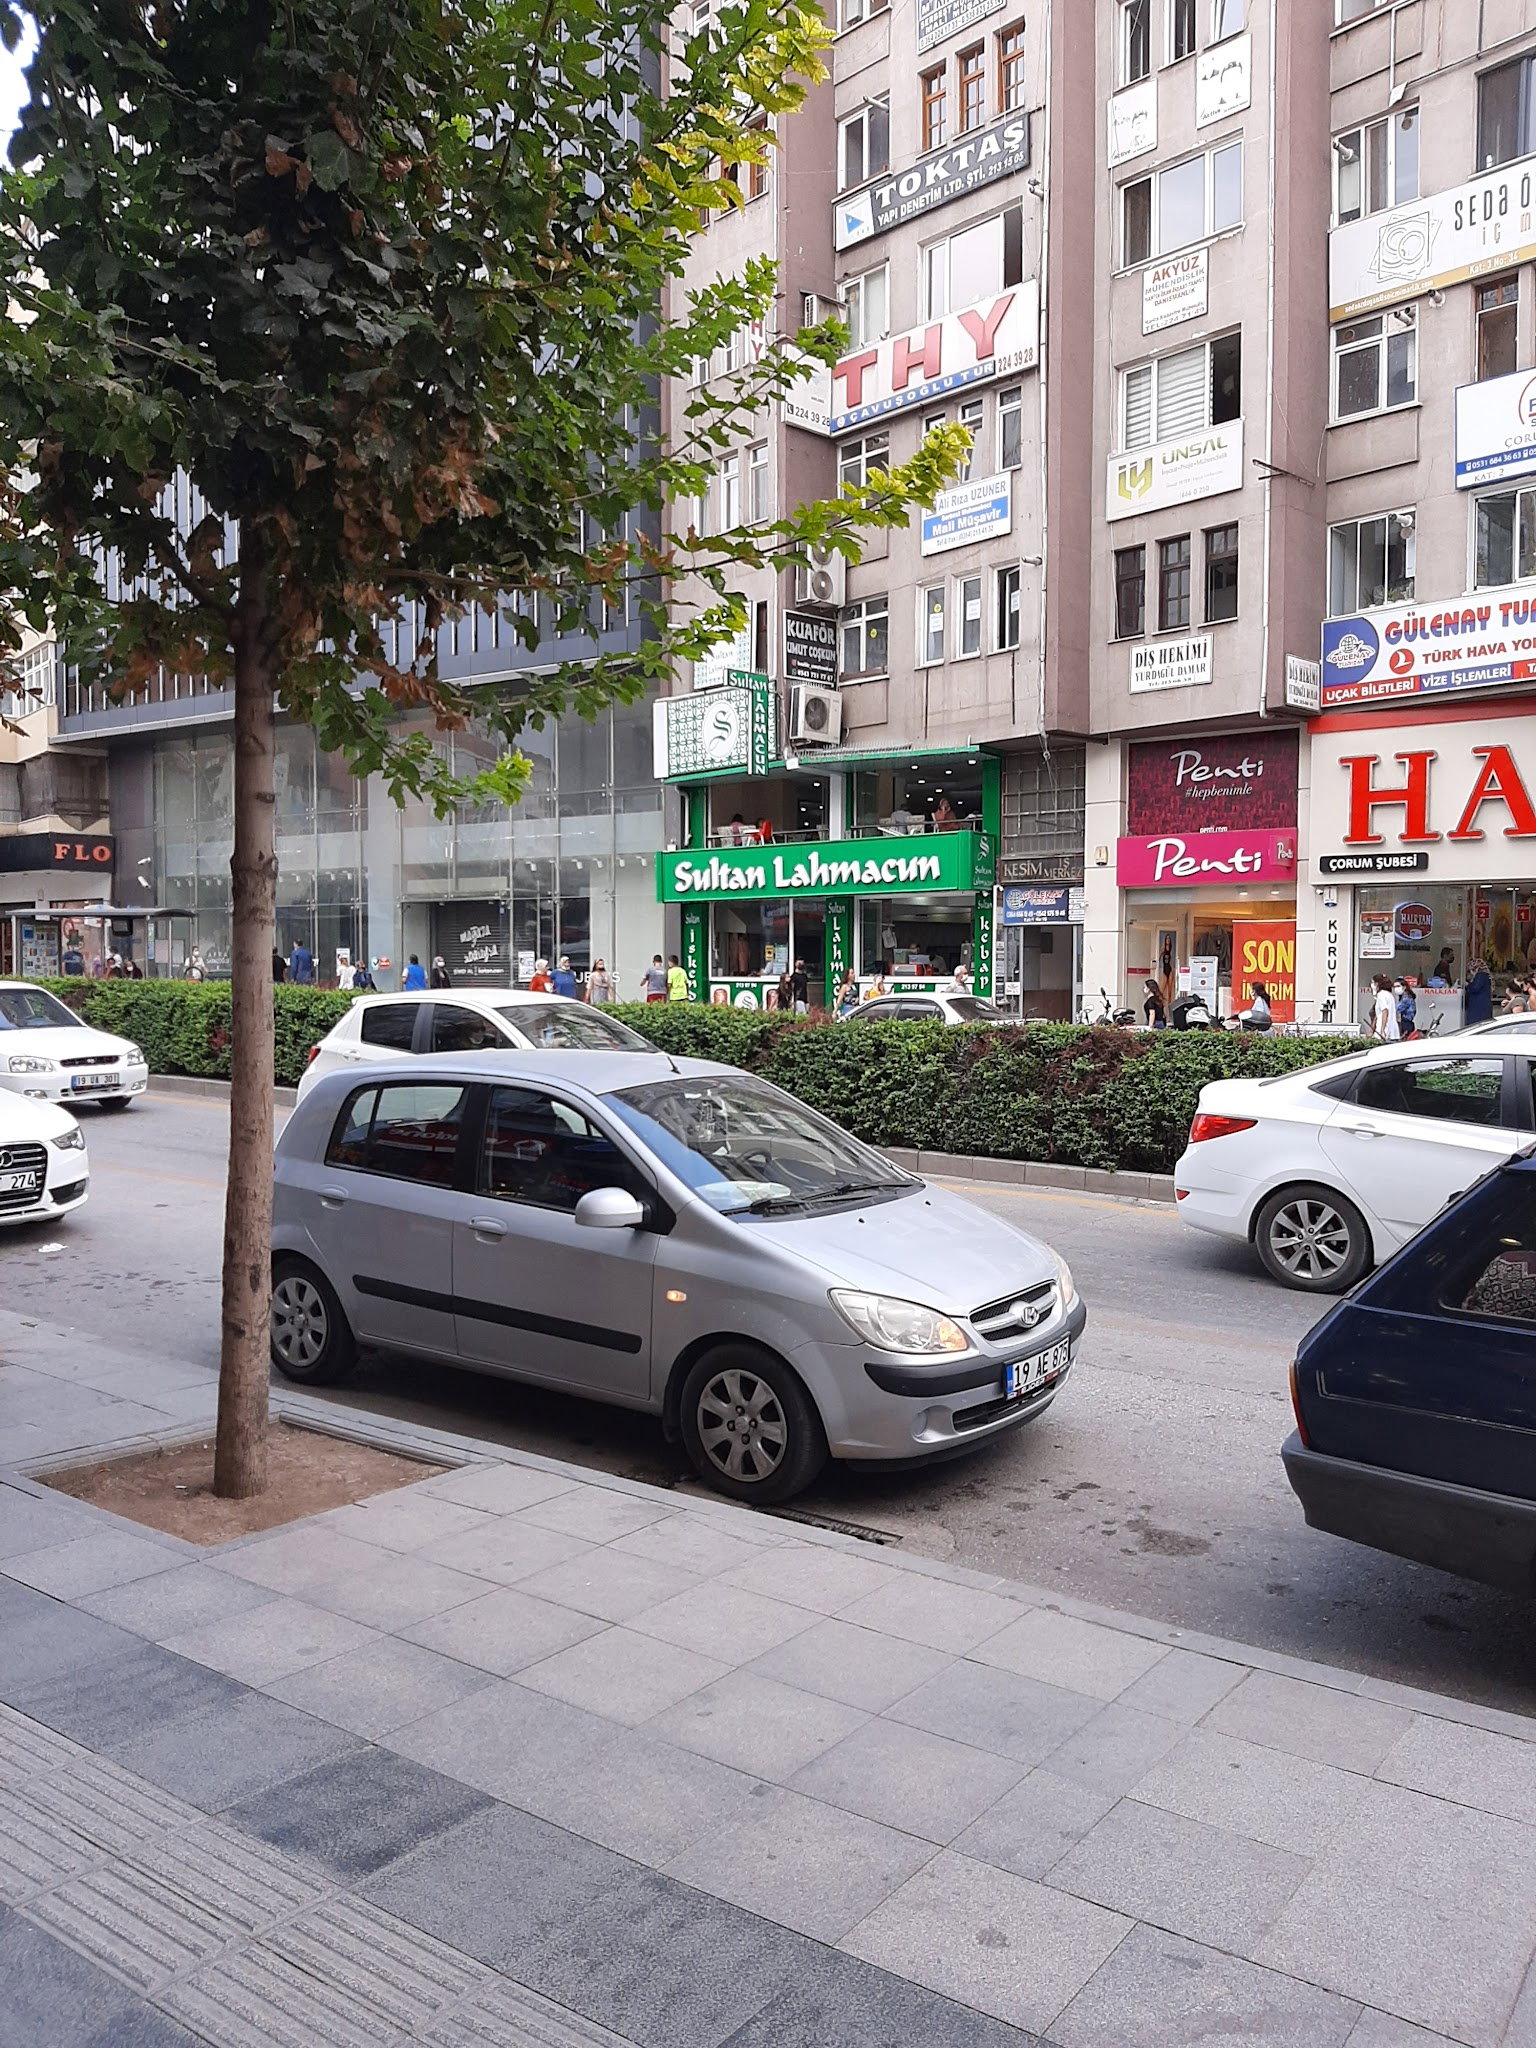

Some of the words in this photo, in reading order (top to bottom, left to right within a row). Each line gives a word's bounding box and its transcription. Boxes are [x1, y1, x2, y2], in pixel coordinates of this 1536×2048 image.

[875, 120, 1025, 208] TOKTAŞ
[877, 209, 899, 227] YAPI
[900, 187, 942, 216] DENETİM
[943, 177, 965, 197] LTD.
[966, 164, 986, 188] ŞTİ.
[1152, 255, 1200, 284] AKYÜZ
[833, 293, 1016, 409] THY
[849, 376, 954, 424] ÇAVUŞOĞLU
[960, 361, 994, 381] TUR
[1013, 352, 1024, 367] 39
[1023, 347, 1034, 363] 28
[795, 406, 809, 420] 224
[810, 412, 820, 423] 39
[938, 497, 950, 511] Ali
[951, 494, 969, 507] Rıza
[970, 480, 1006, 501] UZUNER
[786, 618, 836, 646] KUAFÖR
[1384, 605, 1492, 646] GÜLENAY
[786, 641, 808, 658] UMUT
[1135, 648, 1155, 669] DİŞ
[1159, 638, 1208, 664] HEKİMİ
[1422, 647, 1463, 665] TÜRK
[1466, 641, 1507, 656] HAVA
[729, 672, 767, 692] Sultan
[1135, 664, 1175, 683] YURDAGÜL
[1177, 662, 1206, 676] DAMAR
[1326, 686, 1359, 702] UÇAK
[1361, 677, 1414, 697] BİLETLERİ
[1422, 671, 1448, 687] VİZE
[1450, 662, 1512, 686] İŞLEMLERİ
[753, 692, 767, 775] LAHMACUN
[1170, 749, 1264, 786] Penti
[1185, 783, 1253, 800] #hepbenimle
[54, 843, 112, 862] FLO
[1146, 838, 1262, 882] Penti
[1329, 856, 1373, 872] ÇORUM
[1375, 853, 1418, 870] ŞUBESİ
[673, 855, 767, 893] Sultan
[772, 851, 941, 889] Lahmacun
[974, 865, 992, 875] Sultan
[1004, 860, 1043, 877] KESİM
[979, 915, 990, 990] kebap
[1242, 940, 1294, 974] SON
[1242, 979, 1294, 1001] İNİRİM
[77, 1076, 86, 1085] 19
[104, 1073, 117, 1083] 301
[11, 1173, 35, 1189] 274
[1014, 1362, 1030, 1388] 19
[1035, 1352, 1049, 1380] AE
[1052, 1340, 1069, 1369] 875
